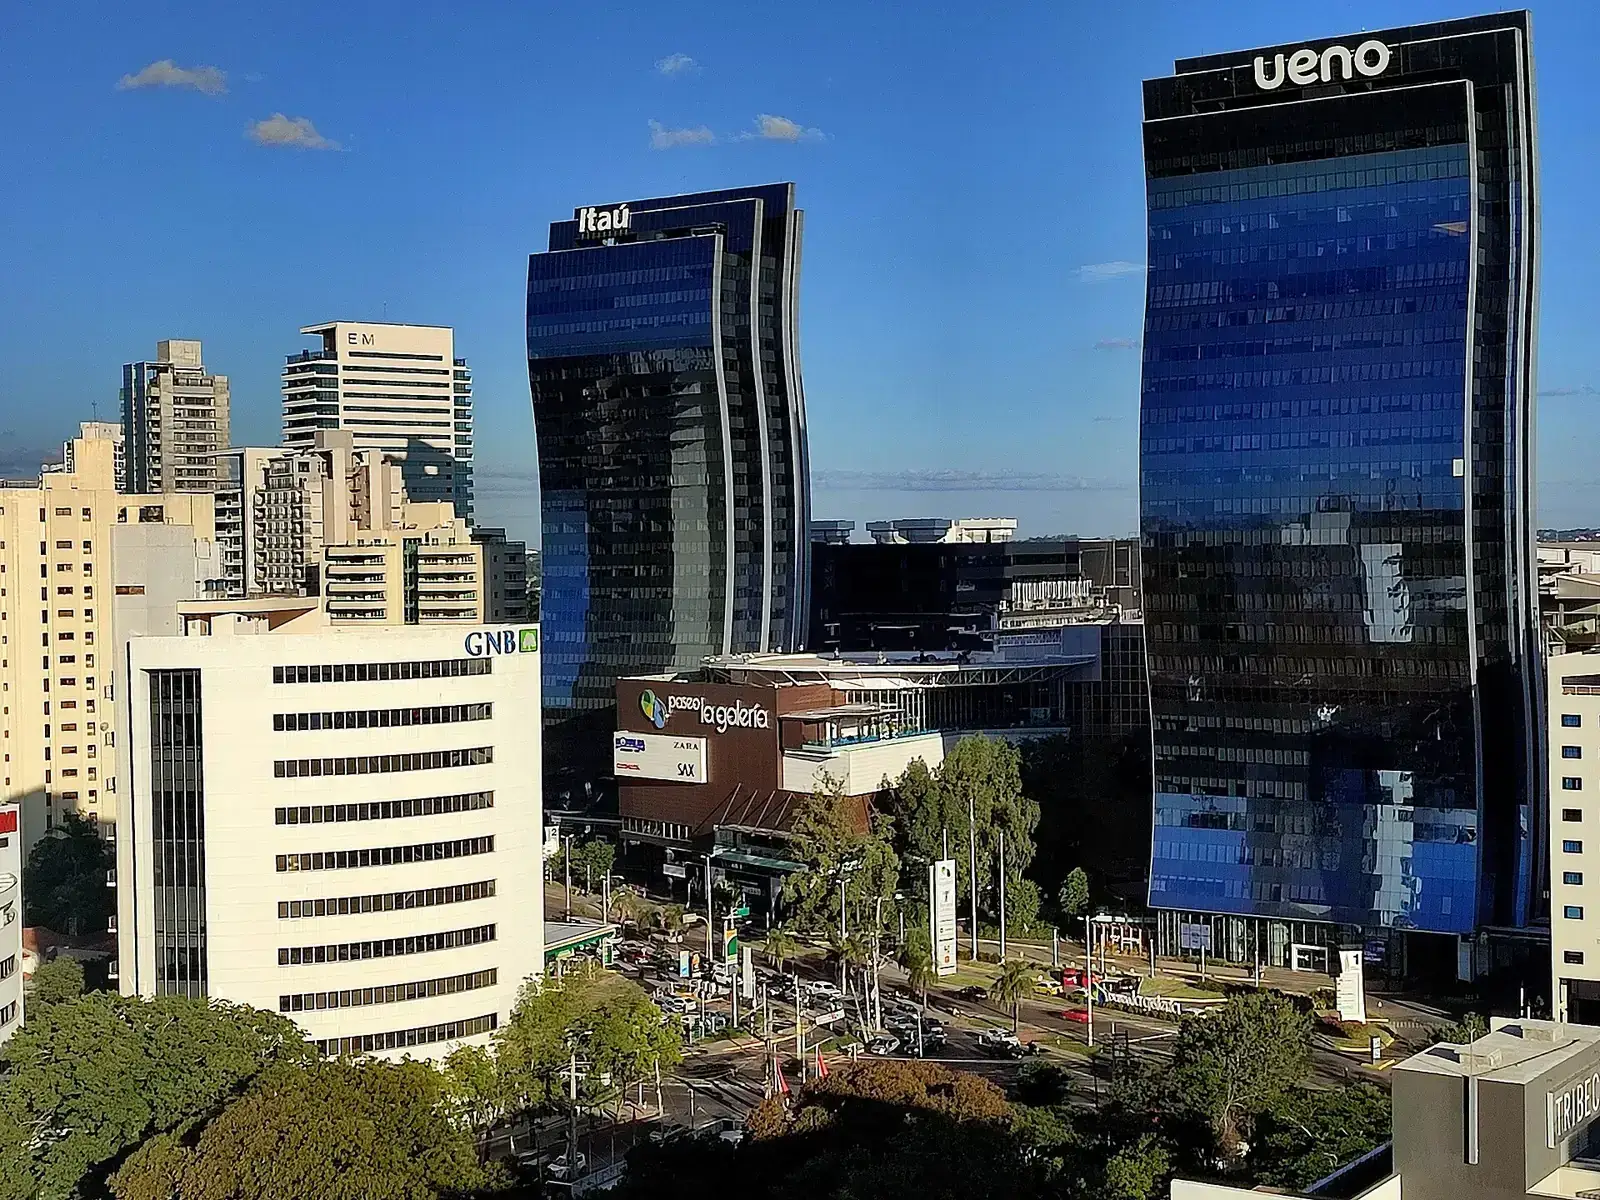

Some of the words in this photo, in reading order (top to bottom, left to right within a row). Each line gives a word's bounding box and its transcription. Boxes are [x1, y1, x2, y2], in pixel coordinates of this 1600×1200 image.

[1254, 40, 1389, 90] ueno
[579, 204, 629, 232] Itaú
[465, 631, 516, 656] GNB
[668, 696, 700, 713] paseo
[673, 741, 699, 751] ZARA
[677, 763, 695, 778] SAX
[551, 828, 557, 837] 2
[1353, 953, 1359, 965] 1
